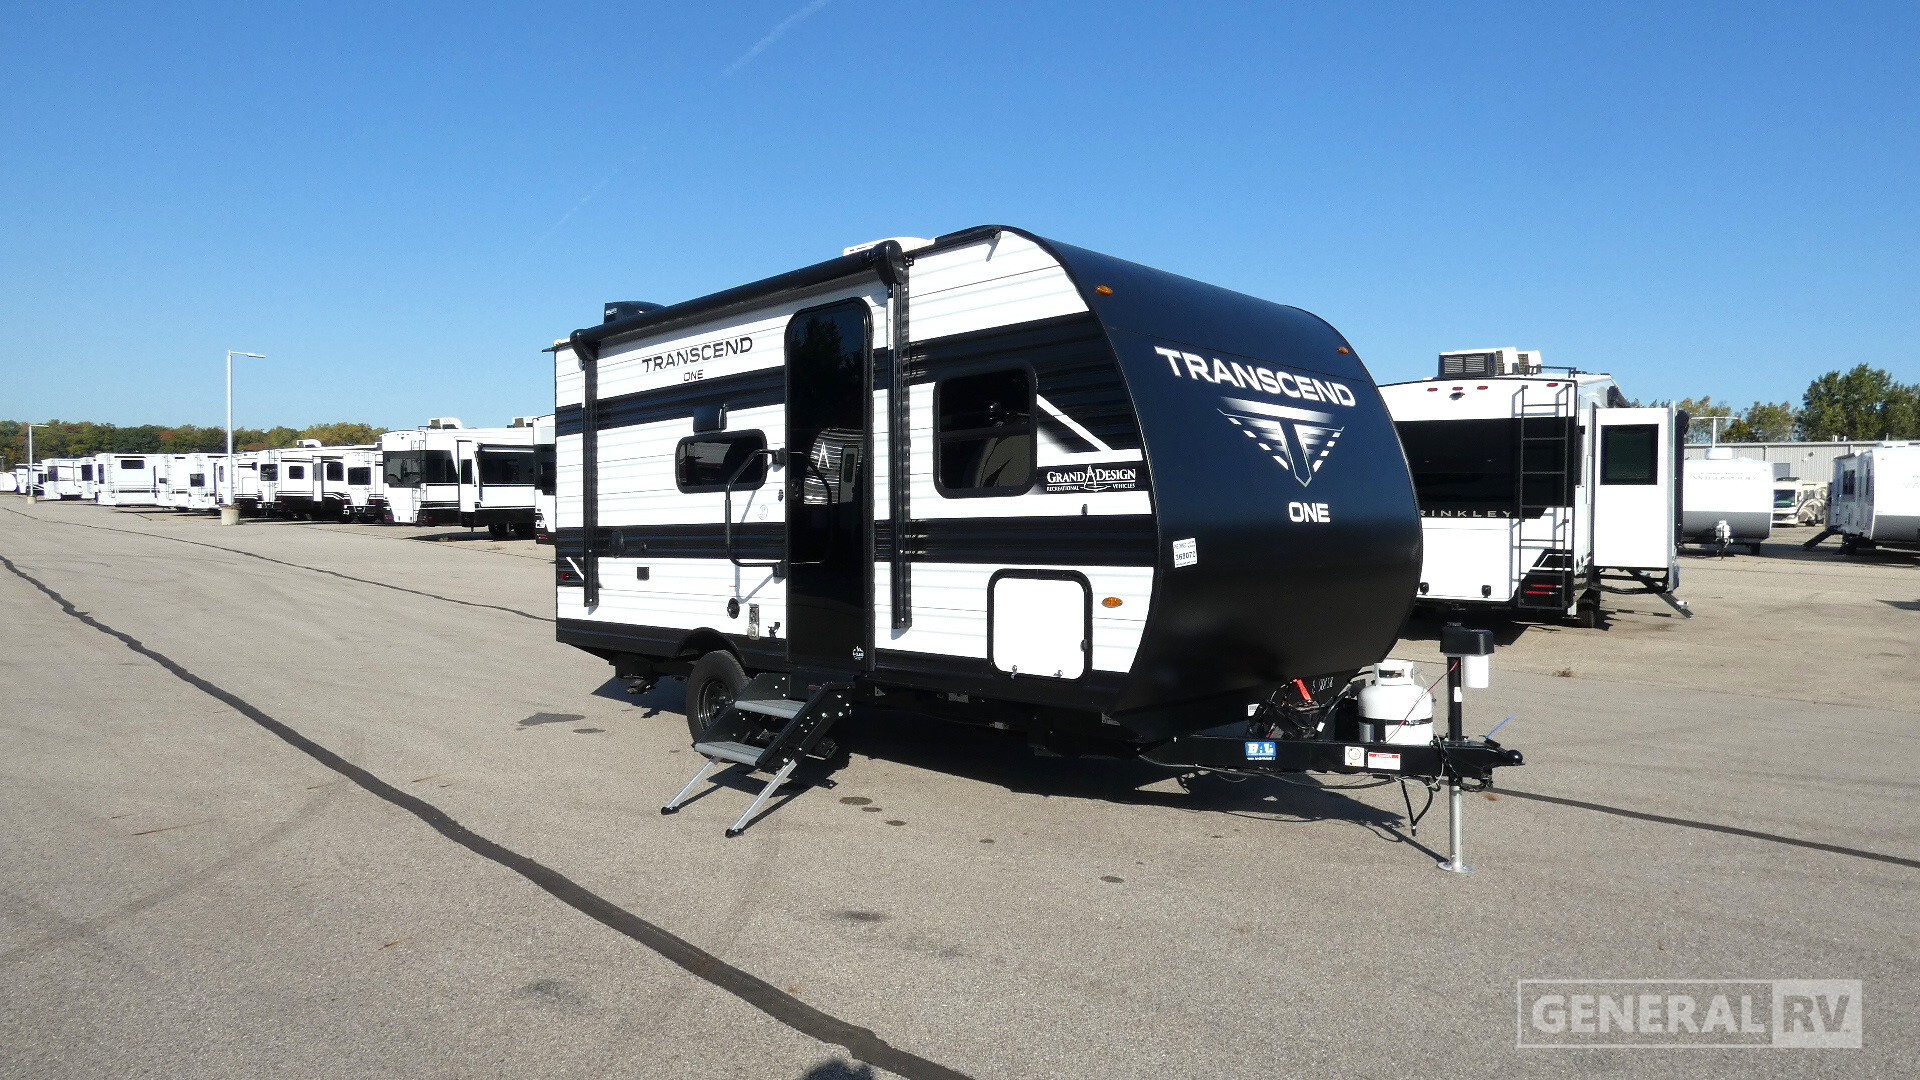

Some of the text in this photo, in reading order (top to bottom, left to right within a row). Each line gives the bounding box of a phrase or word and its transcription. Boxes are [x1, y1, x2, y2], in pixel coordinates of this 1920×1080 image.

[642, 337, 753, 373] TRANSCEND
[683, 369, 704, 381] ONE
[1154, 346, 1356, 407] TRANSCEND
[1046, 468, 1136, 483] GRAND DESIGN
[1288, 502, 1331, 523] ONE
[1420, 509, 1511, 518] RINKLEY
